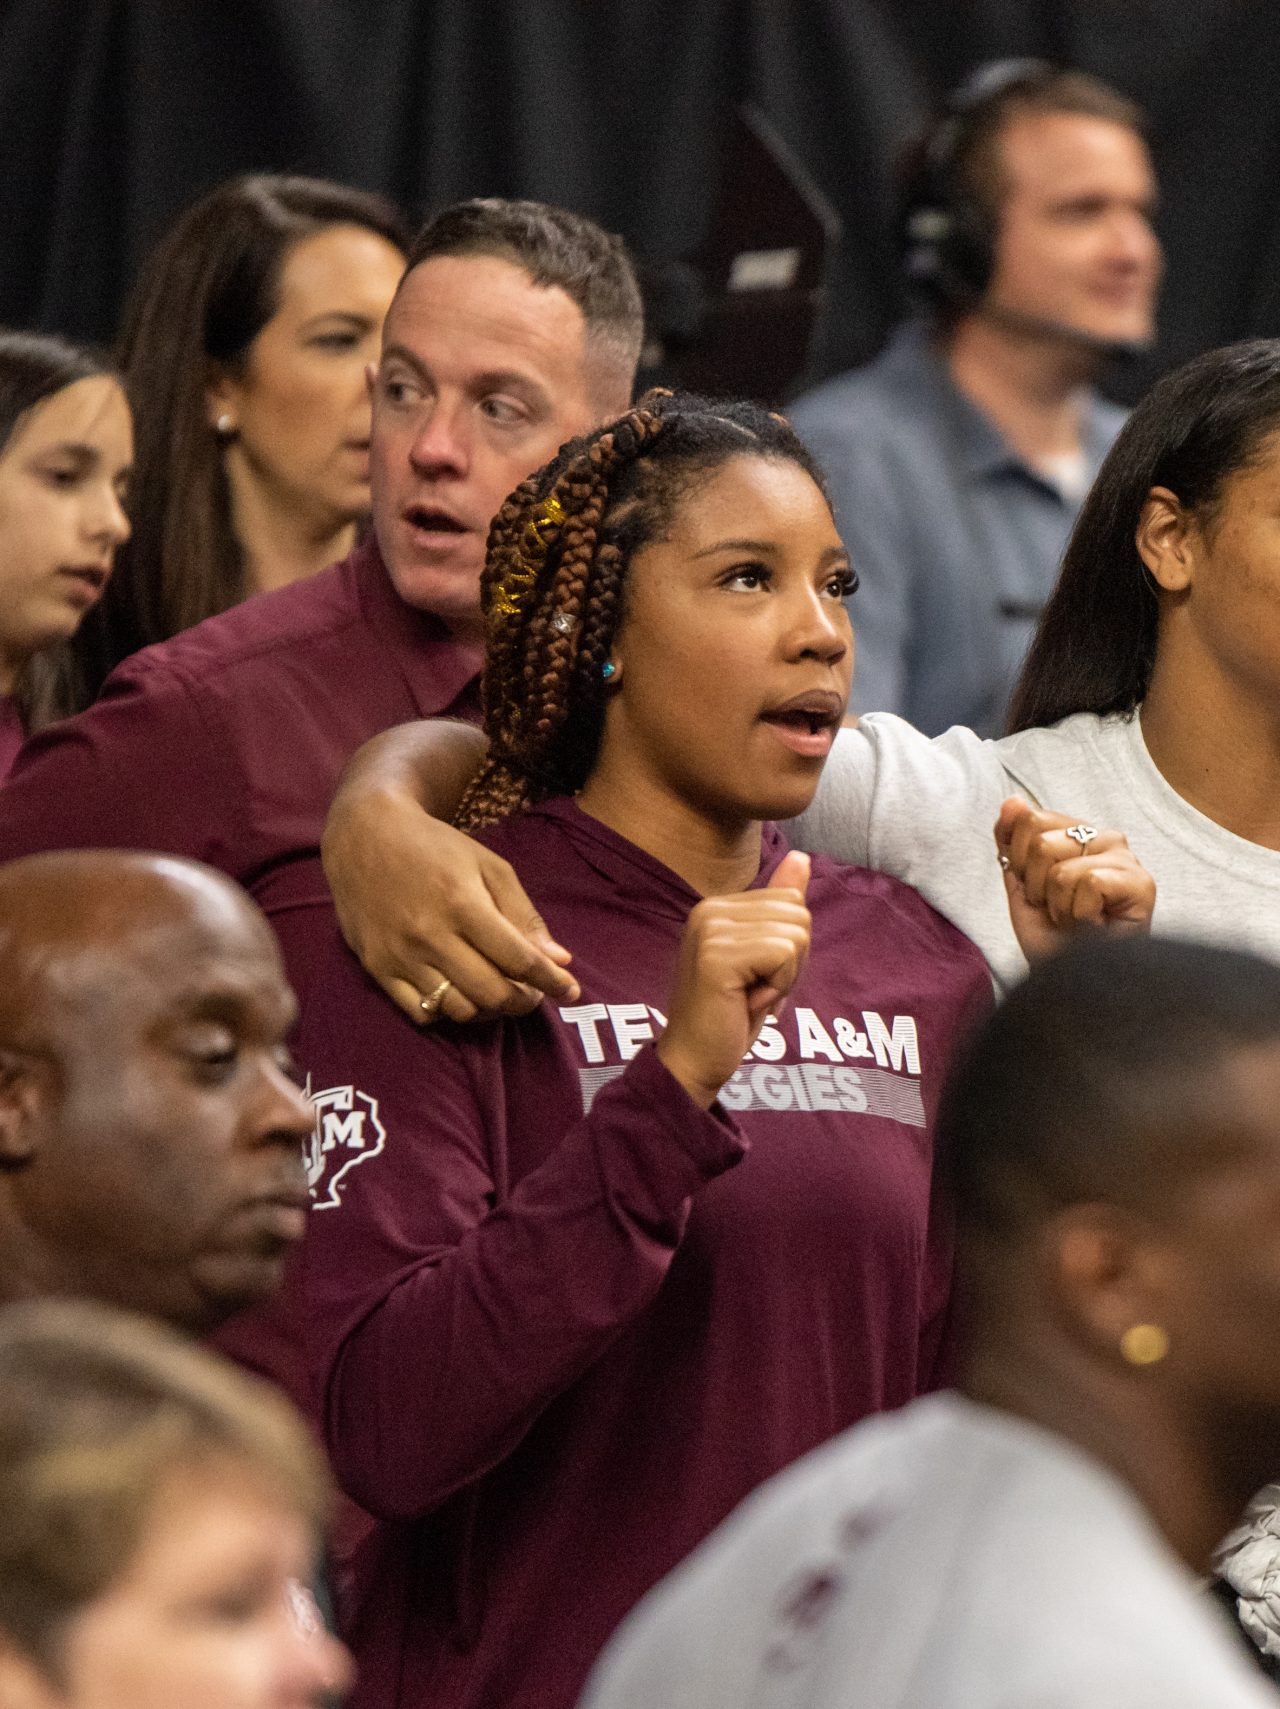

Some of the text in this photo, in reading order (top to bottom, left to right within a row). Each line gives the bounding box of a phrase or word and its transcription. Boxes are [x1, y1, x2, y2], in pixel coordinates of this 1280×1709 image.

[558, 1003, 921, 1074] TES A&M
[716, 1063, 868, 1112] GGIES
